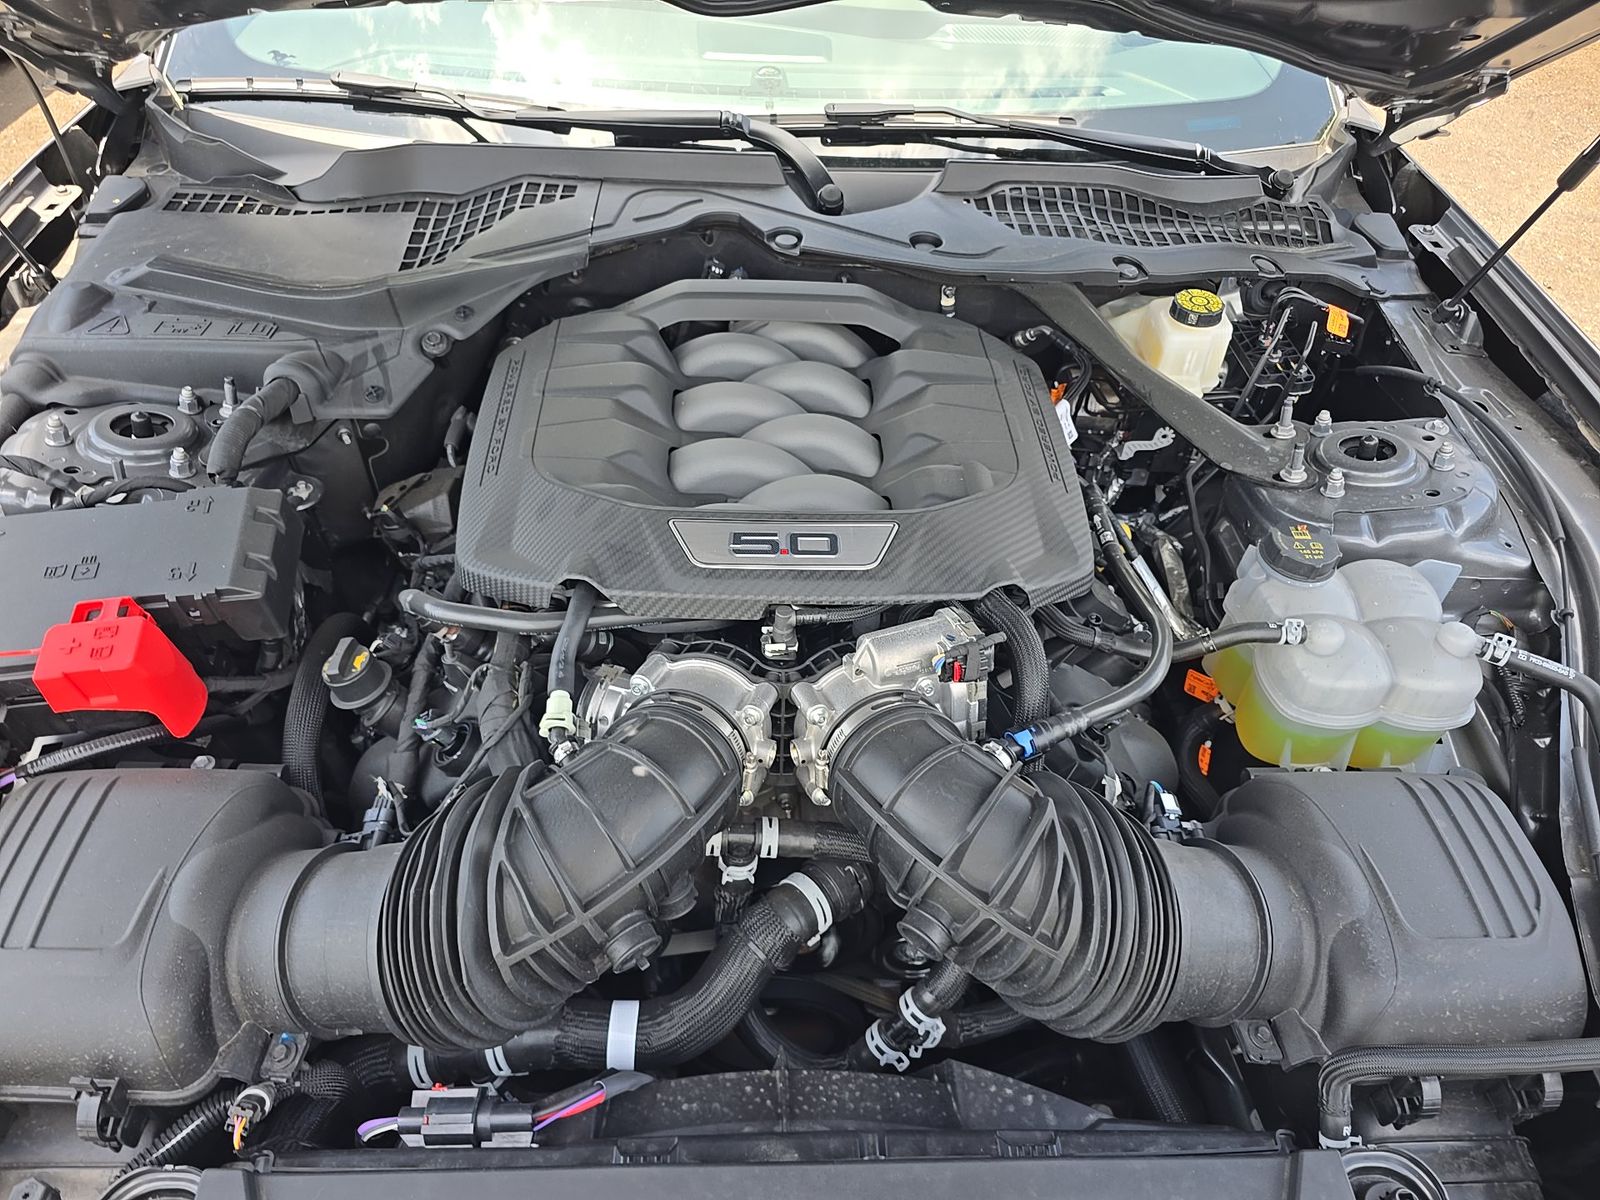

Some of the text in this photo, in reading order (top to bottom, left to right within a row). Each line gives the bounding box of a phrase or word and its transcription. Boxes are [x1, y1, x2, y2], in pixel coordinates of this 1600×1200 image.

[1029, 400, 1040, 416] BY
[496, 419, 506, 433] BY
[487, 439, 501, 474] FORD
[1036, 419, 1062, 482] POWERED
[729, 531, 840, 558] 5.0
